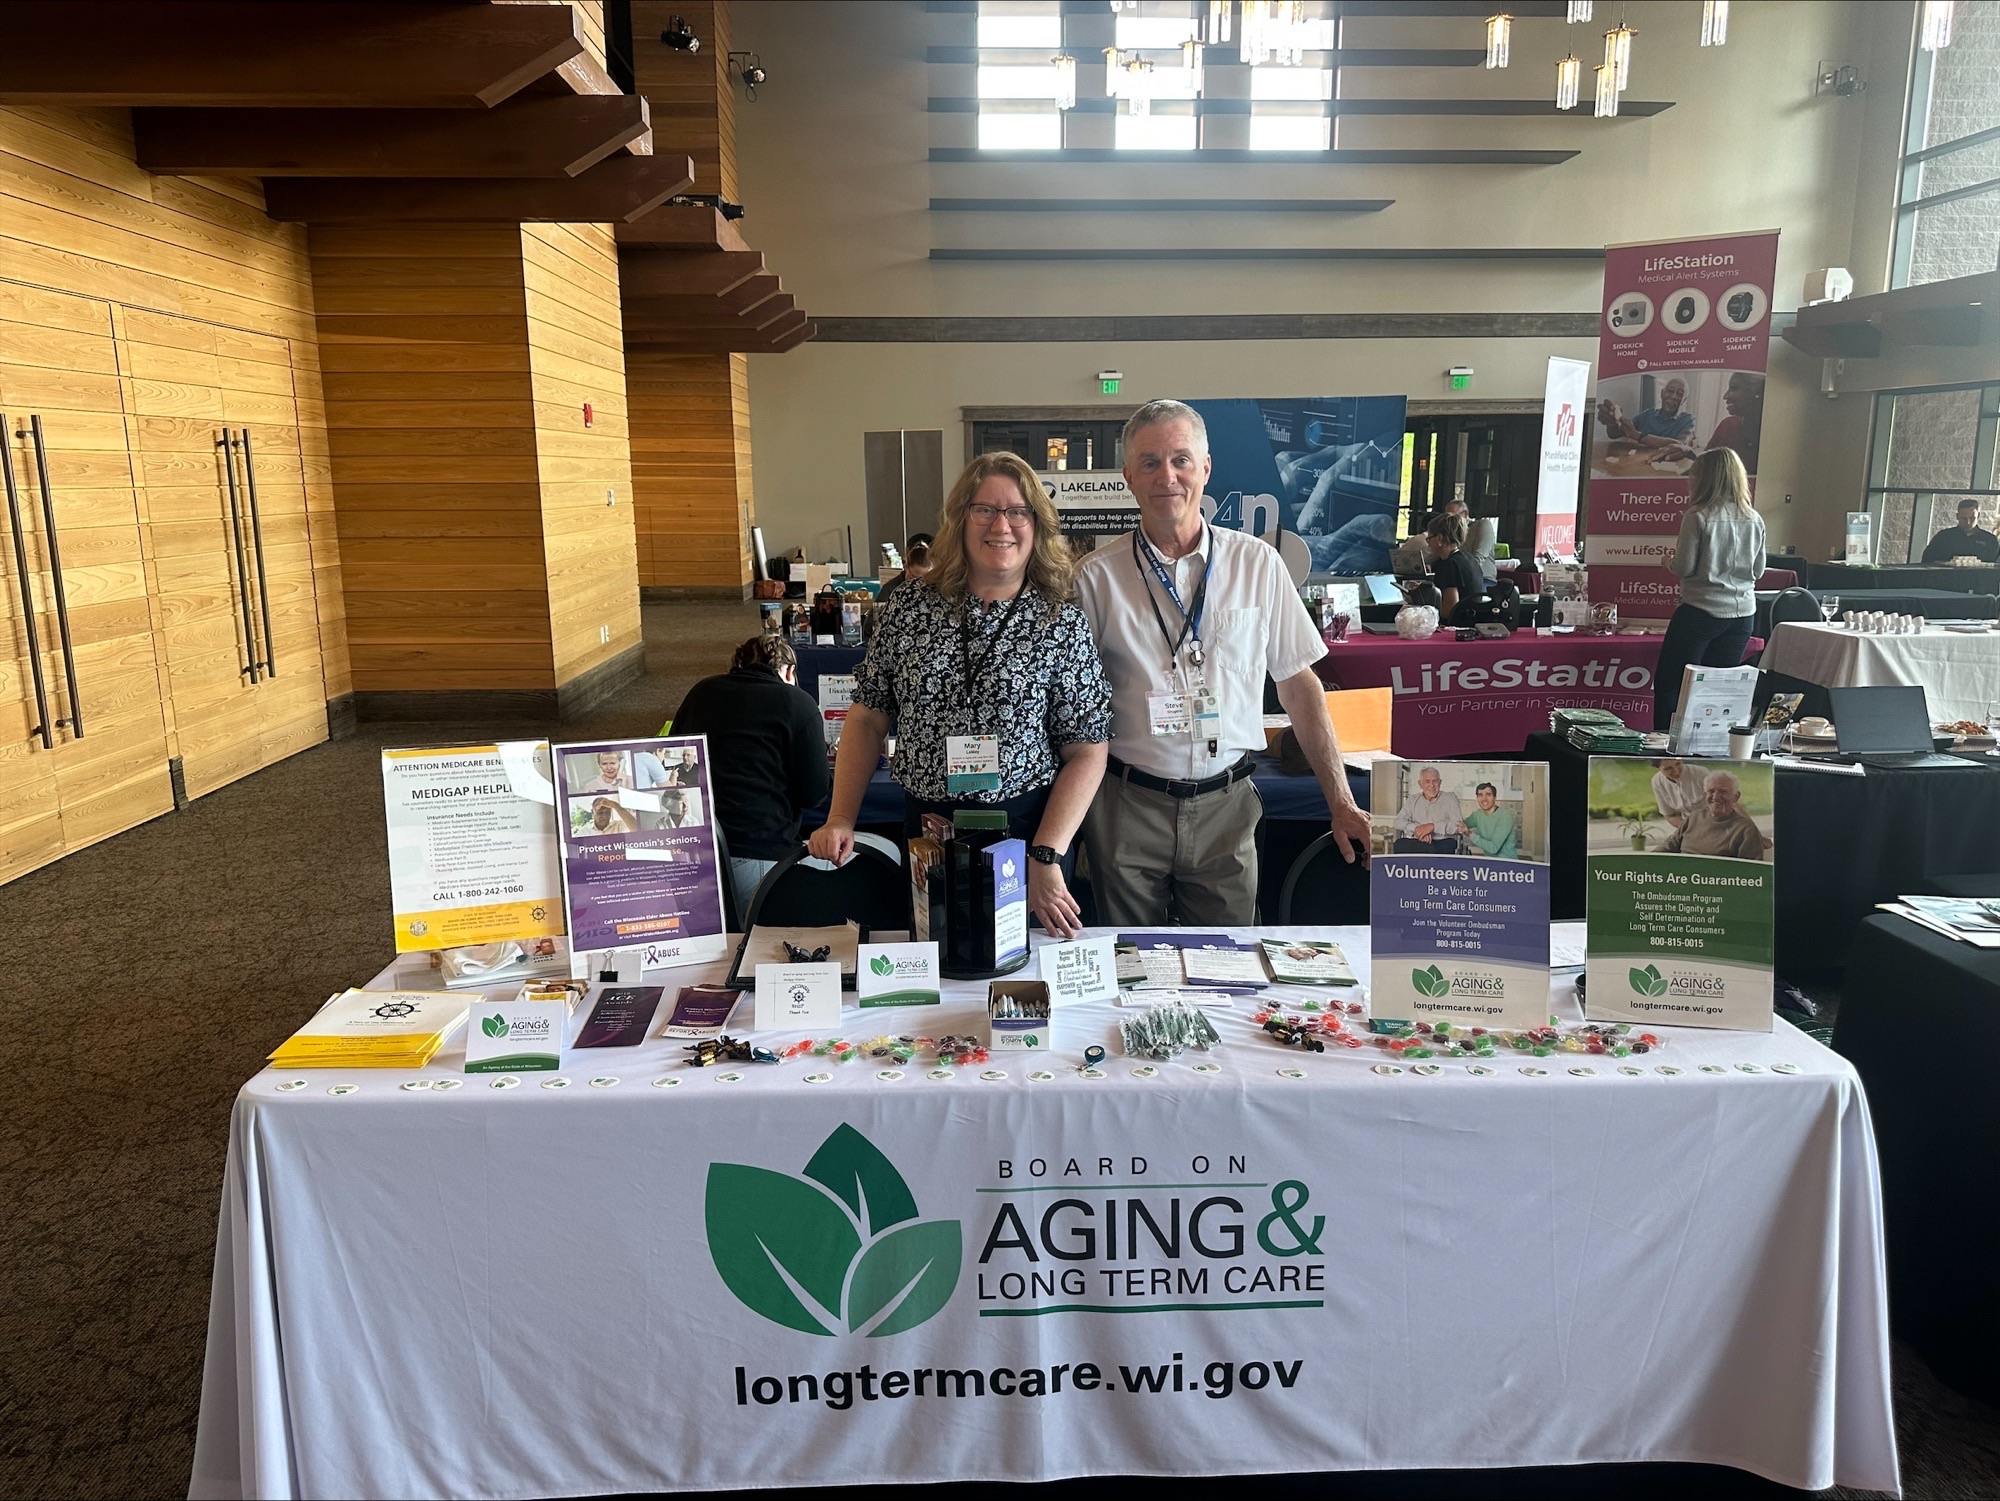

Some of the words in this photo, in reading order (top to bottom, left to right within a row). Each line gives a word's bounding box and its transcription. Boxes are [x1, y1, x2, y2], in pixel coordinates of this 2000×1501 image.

[1645, 254, 1733, 271] LifeStation
[1638, 274, 1674, 283] Medical
[1675, 272, 1697, 280] Alert
[1700, 269, 1739, 279] Systems
[1103, 381, 1120, 394] EXIT
[1452, 376, 1469, 390] EXIT
[1545, 451, 1567, 461] Marshfield
[1061, 482, 1124, 492] LAKELAND
[1620, 493, 1661, 504] There
[1665, 493, 1689, 503] For
[1607, 511, 1676, 522] Wherever
[1309, 527, 1323, 536] 40%
[1541, 525, 1573, 546] WELCOME
[1650, 597, 1673, 605] Alert
[1390, 658, 1654, 695] LifeStatio
[1418, 703, 1454, 715] Your
[1461, 700, 1521, 711] Partner
[1526, 697, 1540, 708] in
[1547, 697, 1596, 708] Senior
[1601, 698, 1649, 713] Health
[393, 763, 439, 772] ATTENTION
[442, 760, 482, 768] MEDICARE
[412, 787, 470, 799] MEDIGAP
[579, 843, 612, 853] Protect
[614, 839, 664, 850] Wisconsin's
[666, 836, 701, 845] Seniors,
[598, 854, 628, 863] Repor
[1384, 864, 1468, 880] Volunteers
[1473, 867, 1534, 883] Wanted
[1595, 870, 1622, 881] Your
[1625, 872, 1663, 885] Rights
[1667, 874, 1687, 884] Are
[1691, 874, 1763, 887] Guaranteed
[433, 892, 455, 901] CALL
[459, 885, 524, 898] 1-800-242-1060
[1428, 886, 1439, 895] Be
[1450, 886, 1473, 897] Voice
[1475, 888, 1488, 897] for
[1632, 891, 1645, 899] The
[1647, 893, 1691, 902] Ombudsman
[1693, 894, 1722, 904] Program
[1400, 899, 1420, 911] Long
[1423, 900, 1443, 910] Term
[1446, 901, 1465, 911] Care
[1468, 901, 1516, 913] Consumers
[1635, 902, 1663, 911] Assures
[1665, 903, 1677, 911] the
[1679, 904, 1704, 914] Dignity
[1706, 905, 1720, 913] and
[623, 915, 645, 923] Wisconsin
[1639, 912, 1653, 921] Self
[1655, 913, 1706, 923] Determination
[1708, 915, 1715, 923] of
[1412, 919, 1425, 927] Join
[1427, 919, 1437, 927] the
[1438, 920, 1466, 929] Volunteer
[1468, 922, 1505, 930] Ombudsman
[1629, 923, 1646, 933] Long
[1648, 923, 1666, 932] Term
[1668, 925, 1683, 933] Care
[1686, 925, 1725, 935] Consumers
[1437, 929, 1462, 938] Program
[1464, 930, 1481, 939] Today
[1436, 940, 1481, 949] 800-815-0015
[1650, 937, 1703, 948] 800-815-0015
[658, 948, 680, 959] ABUSE
[1413, 1002, 1504, 1014] longtermcare.wi.gov
[1630, 1001, 1723, 1014] longtermcare.wi.gov
[999, 1156, 1149, 1180] BOARD
[1192, 1155, 1248, 1175] ON
[977, 1268, 1087, 1301] LONG
[1100, 1267, 1210, 1297] TERM
[1224, 1264, 1325, 1294] CARE
[735, 1352, 1304, 1411] longtermcare.wi.gov
